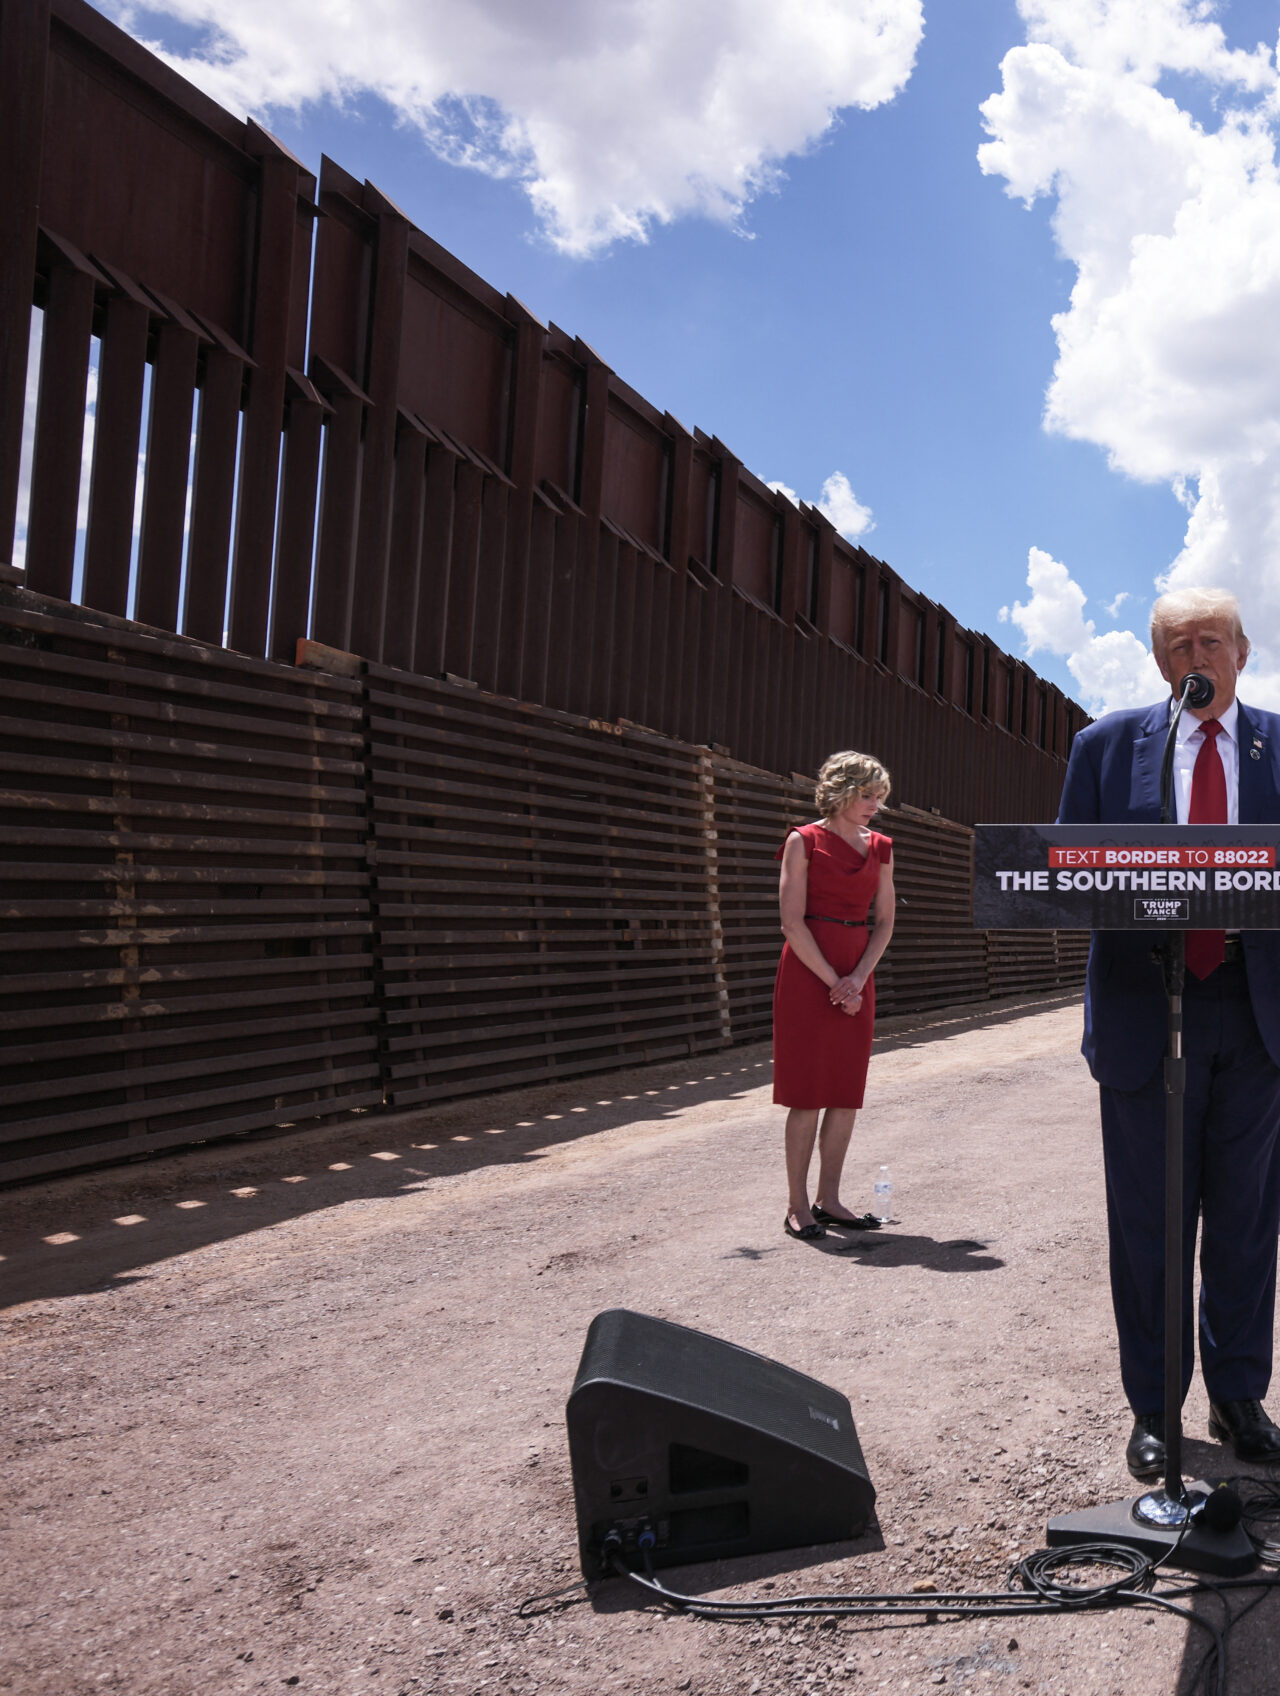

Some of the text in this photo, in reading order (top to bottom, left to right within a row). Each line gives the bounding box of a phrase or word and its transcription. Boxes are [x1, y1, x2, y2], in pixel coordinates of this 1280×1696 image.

[1055, 850, 1269, 864] TEXT BORDER TO 88022
[995, 871, 1049, 891] THE
[1056, 870, 1206, 891] SOUTHERN
[1142, 901, 1181, 909] TRUMP
